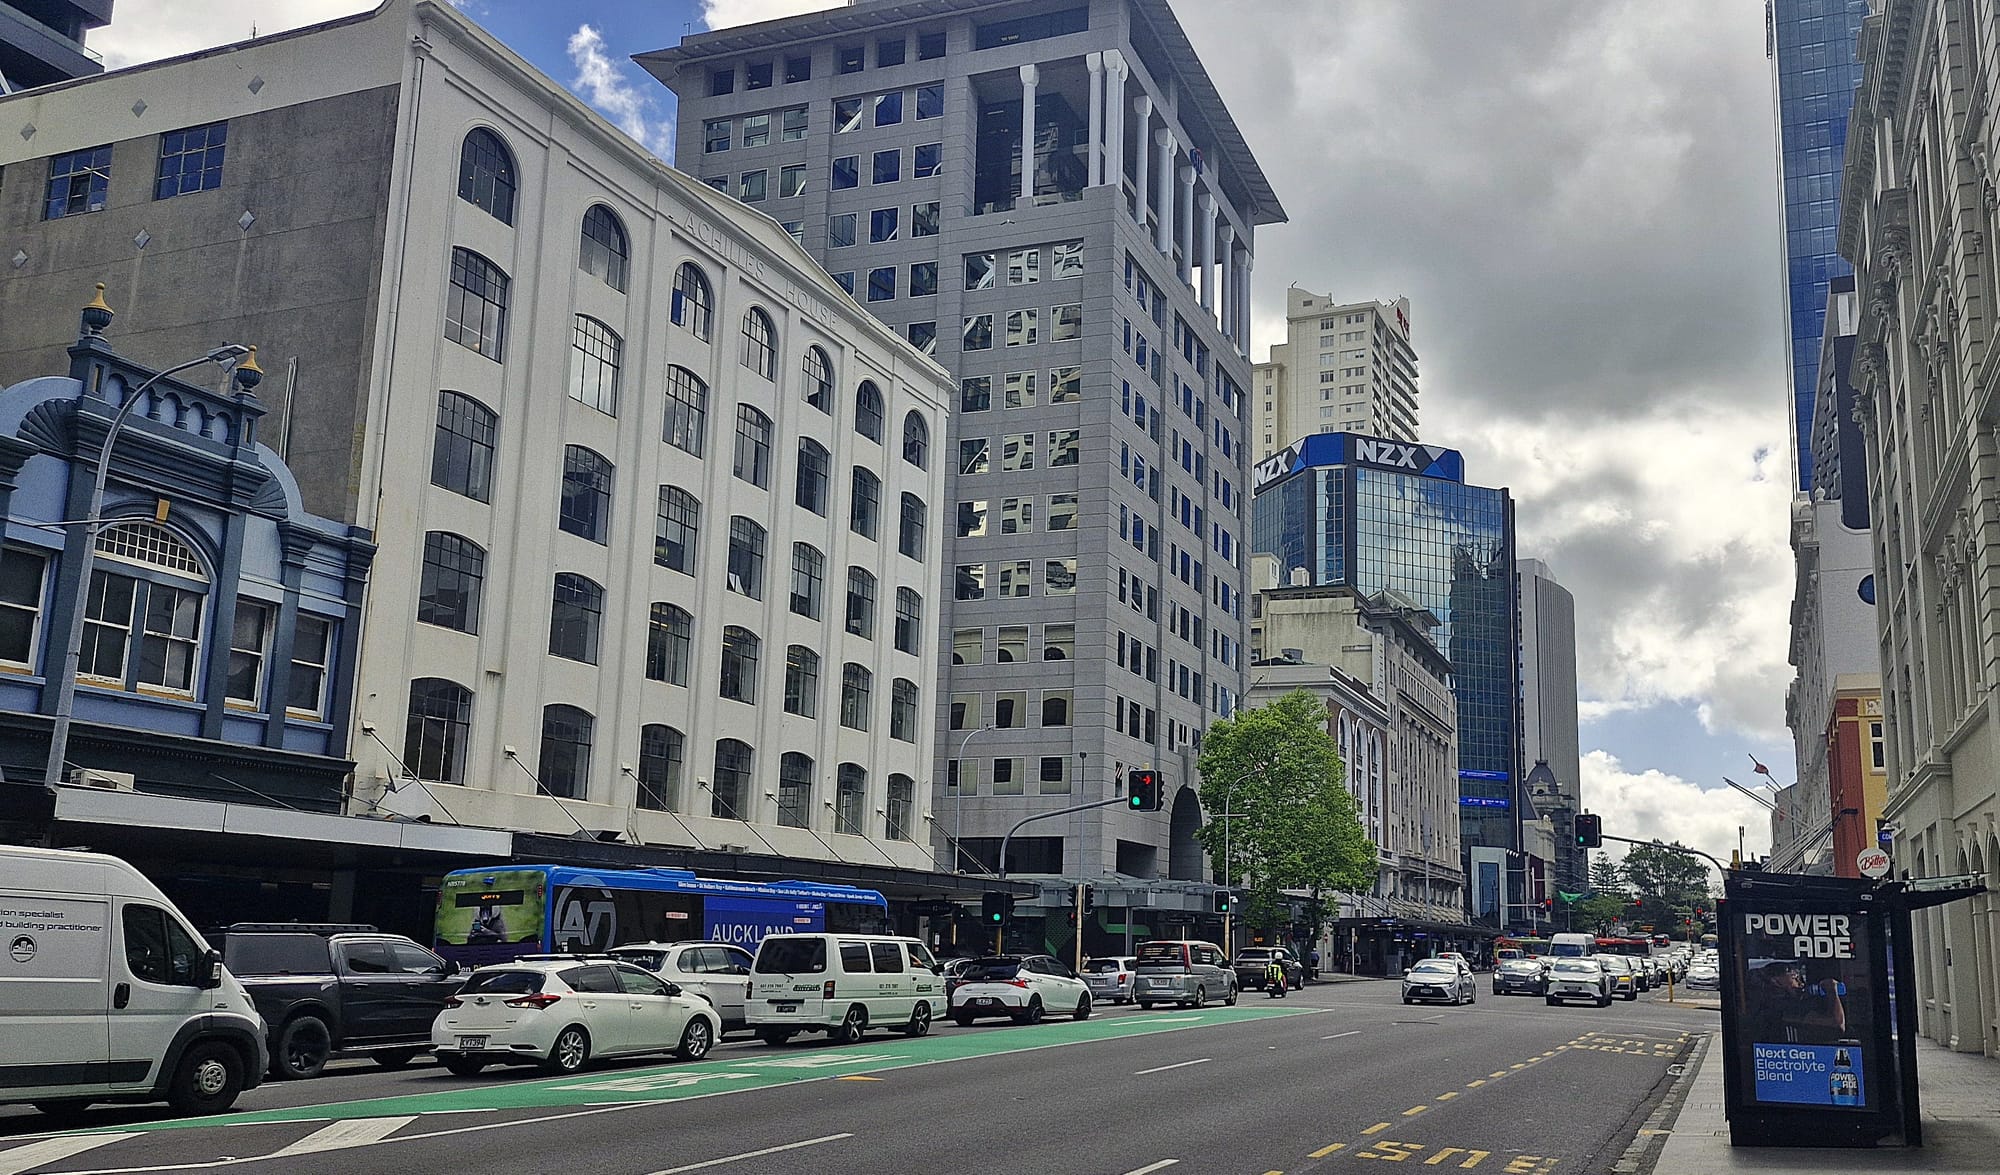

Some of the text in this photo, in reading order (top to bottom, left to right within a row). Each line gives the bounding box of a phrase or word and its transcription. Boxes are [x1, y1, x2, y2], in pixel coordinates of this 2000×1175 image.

[683, 212, 837, 330] ACHILLES HOUSE
[1356, 438, 1418, 470] NZX
[1254, 451, 1290, 489] NZX
[6, 921, 45, 931] building
[47, 923, 102, 932] practitioner
[19, 911, 64, 919] specialist
[561, 900, 616, 946] AT
[1745, 913, 1850, 936] POWER
[1793, 935, 1852, 959] ADE
[1755, 1047, 1815, 1060] Next Gen
[1756, 1059, 1826, 1074] Electrolyte
[1757, 1070, 1793, 1082] Blend
